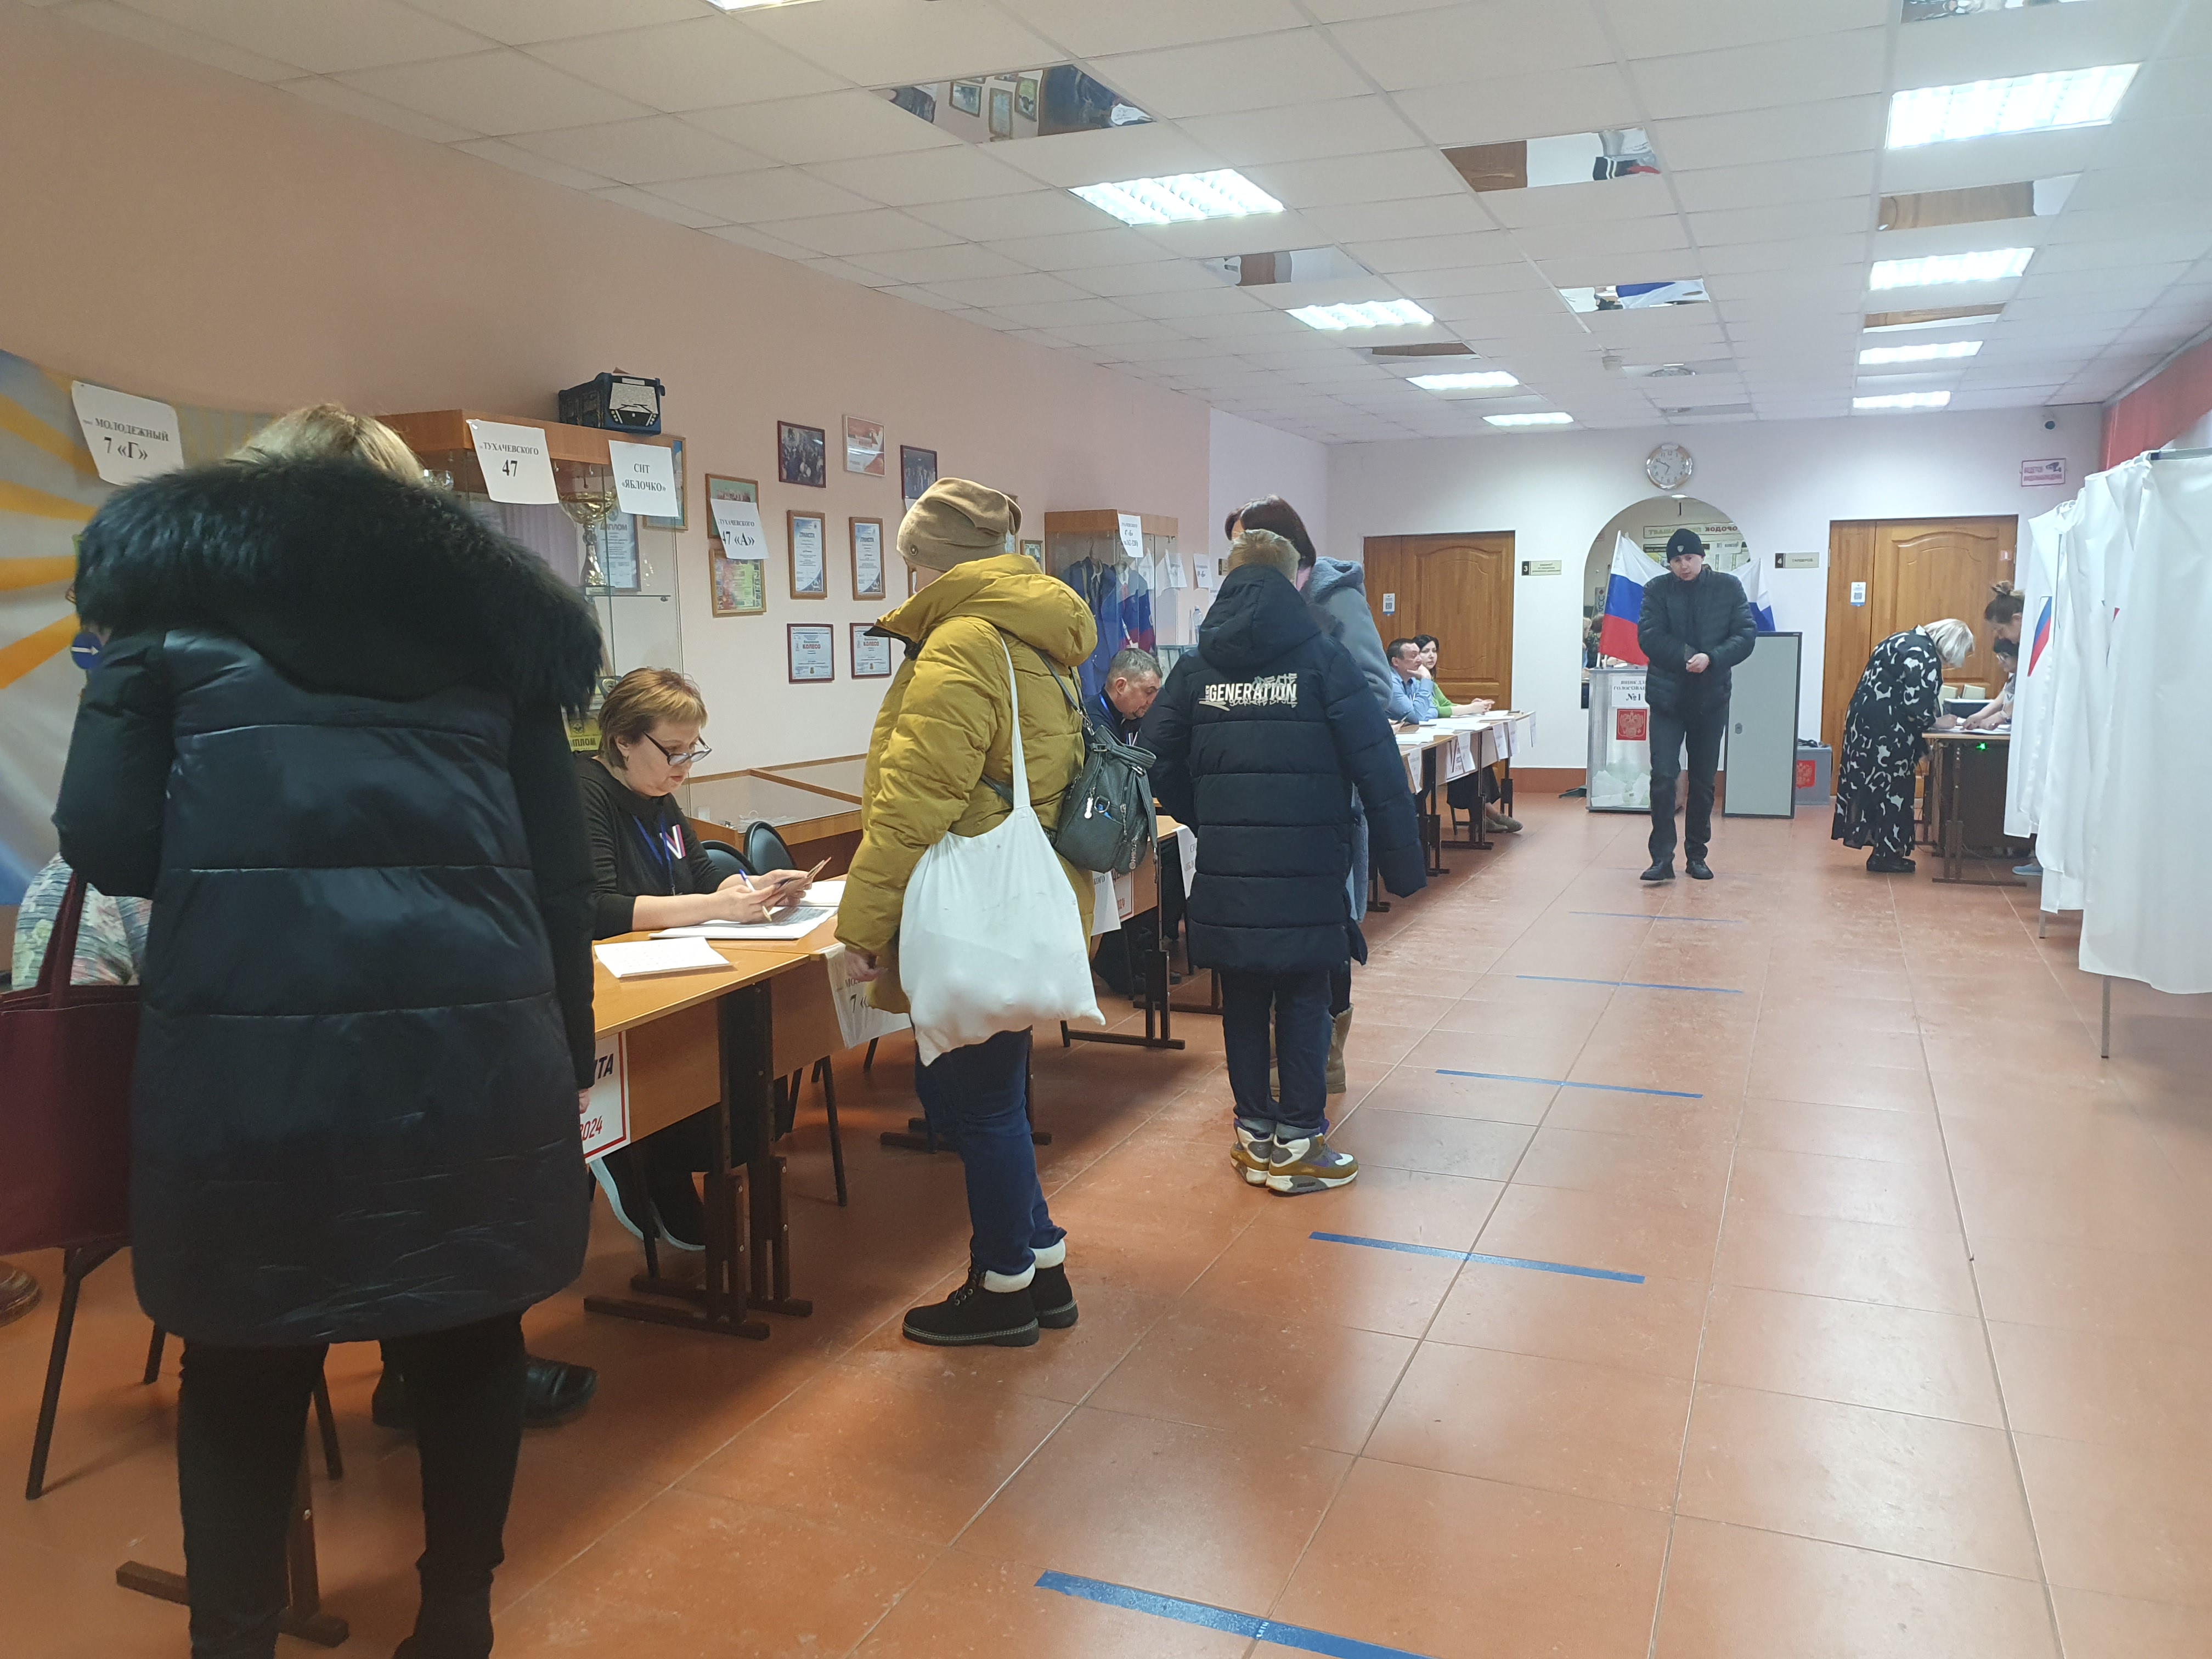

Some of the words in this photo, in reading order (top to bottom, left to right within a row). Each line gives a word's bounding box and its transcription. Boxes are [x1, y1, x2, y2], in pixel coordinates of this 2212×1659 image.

[95, 418, 170, 442] МОЛОДЕЖНЫЙ
[104, 436, 112, 454] 7
[117, 441, 148, 460] «Г»
[483, 442, 539, 455] ТУХАЧЕВСКОГО
[502, 459, 518, 477] 47
[634, 463, 650, 474] СНТ
[622, 479, 666, 492] «ЯБЛОЧКО»
[734, 532, 755, 546] «А»
[1209, 682, 1297, 702] GENERATION
[850, 994, 857, 1013] 7
